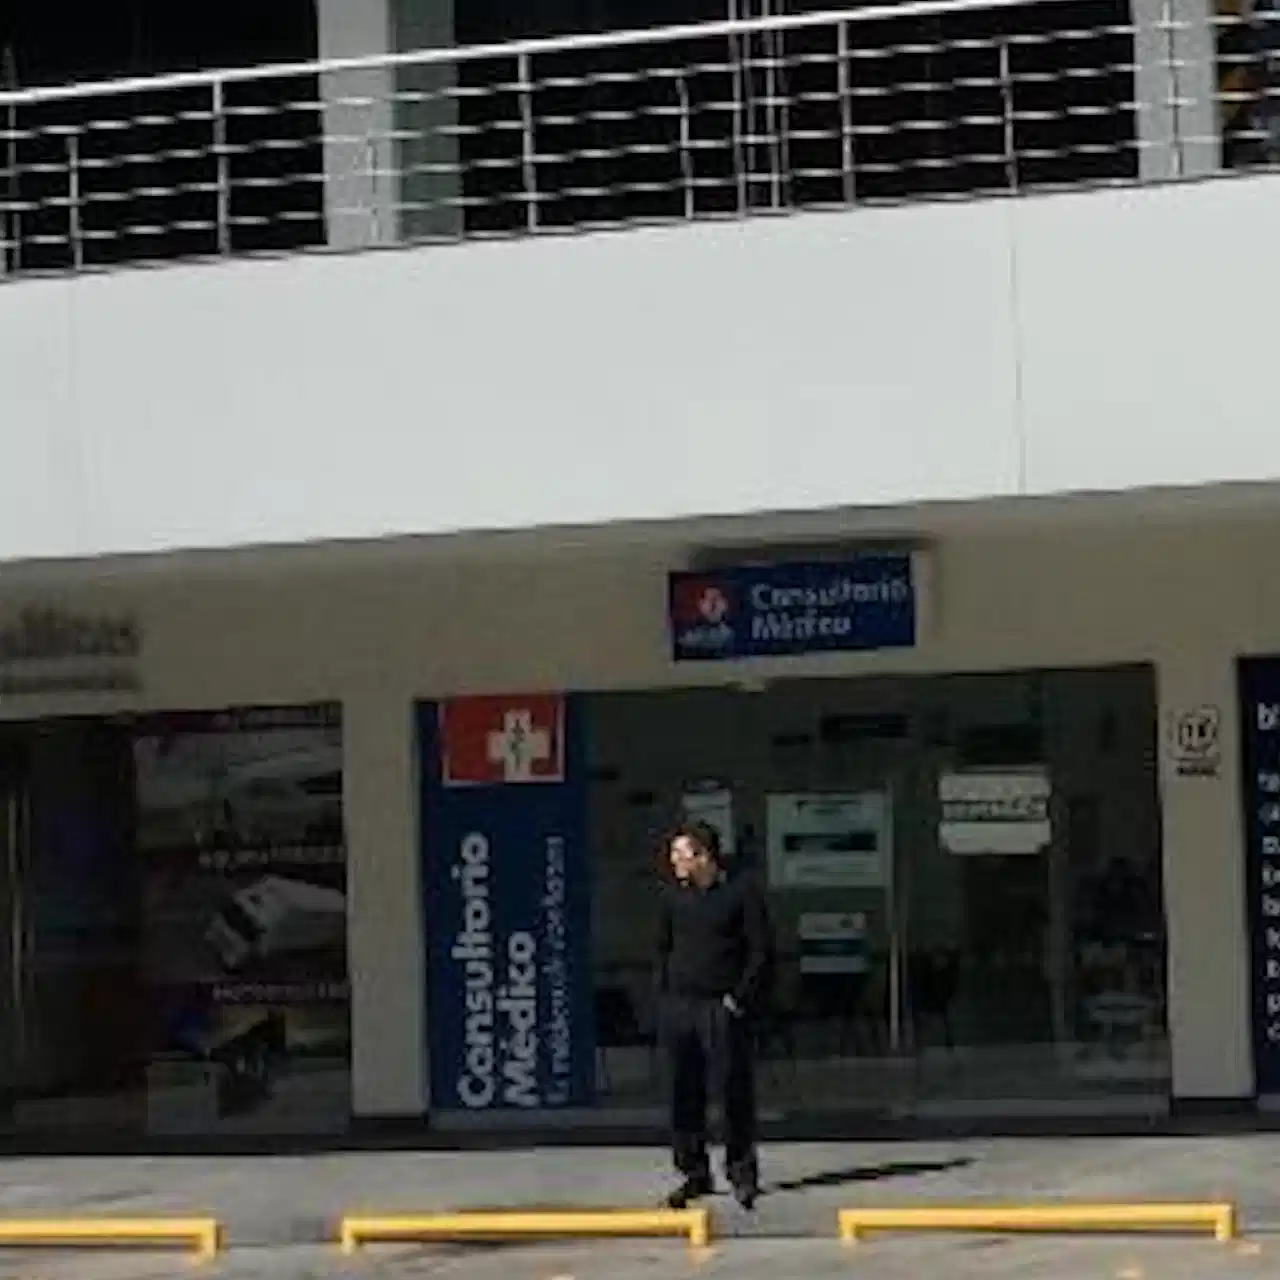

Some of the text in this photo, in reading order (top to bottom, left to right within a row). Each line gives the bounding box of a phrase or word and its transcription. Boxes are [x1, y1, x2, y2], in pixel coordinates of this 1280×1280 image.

[750, 576, 908, 611] Consultorio
[450, 831, 495, 1108] Consultorio
[496, 930, 540, 1108] Médico
